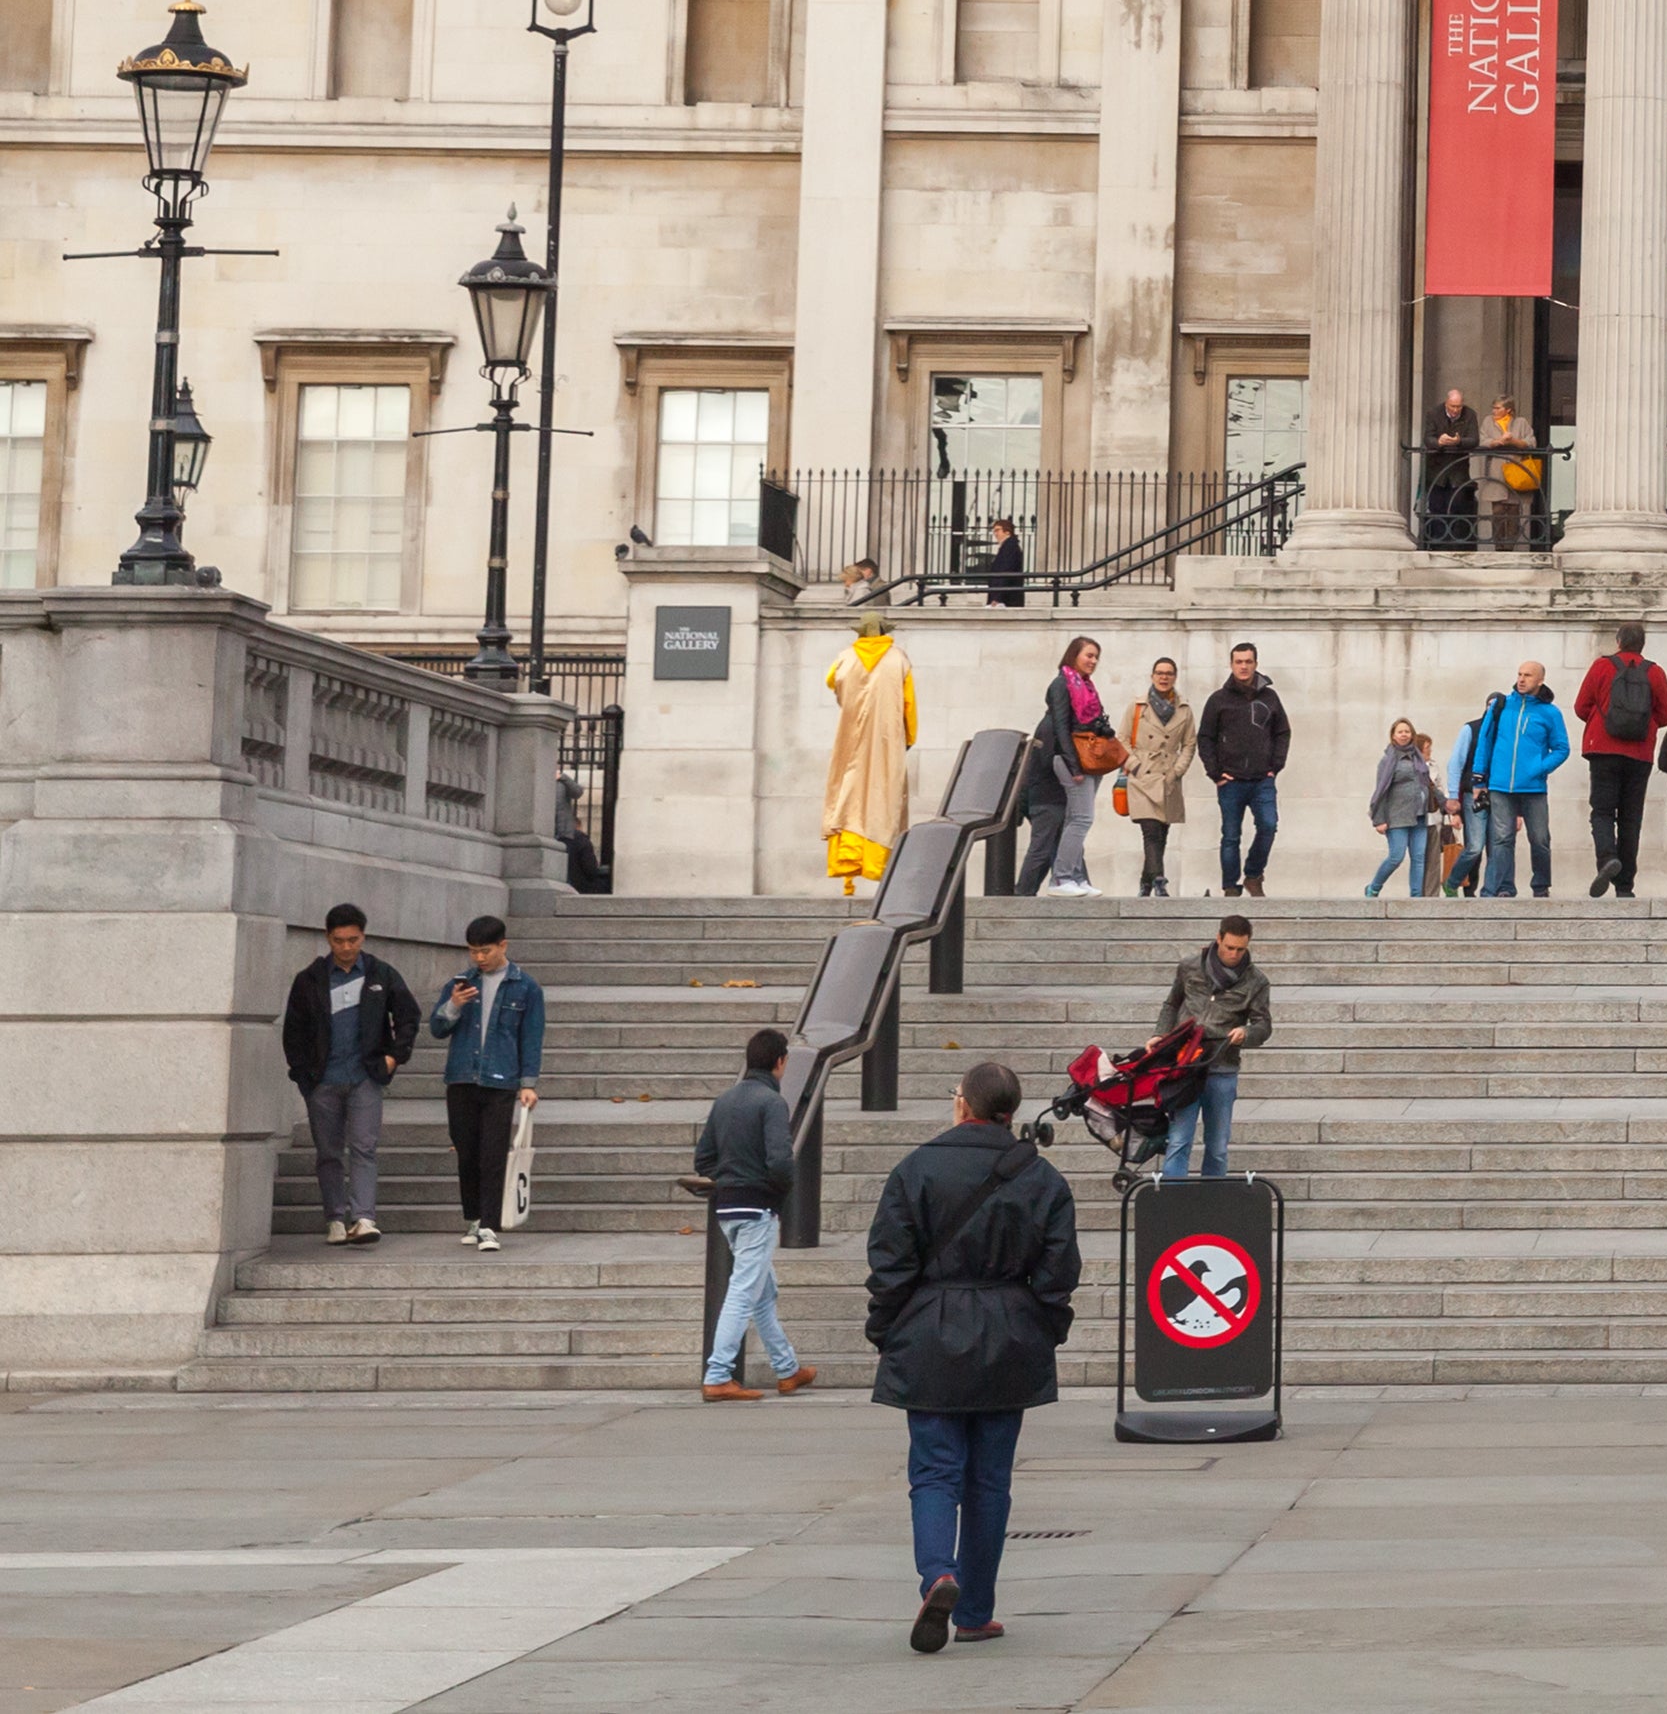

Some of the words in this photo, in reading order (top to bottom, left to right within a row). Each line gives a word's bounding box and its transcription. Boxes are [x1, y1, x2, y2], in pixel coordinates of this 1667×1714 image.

[1448, 14, 1464, 57] THE
[664, 632, 718, 640] NATIONAL
[663, 640, 720, 650] GALLERY
